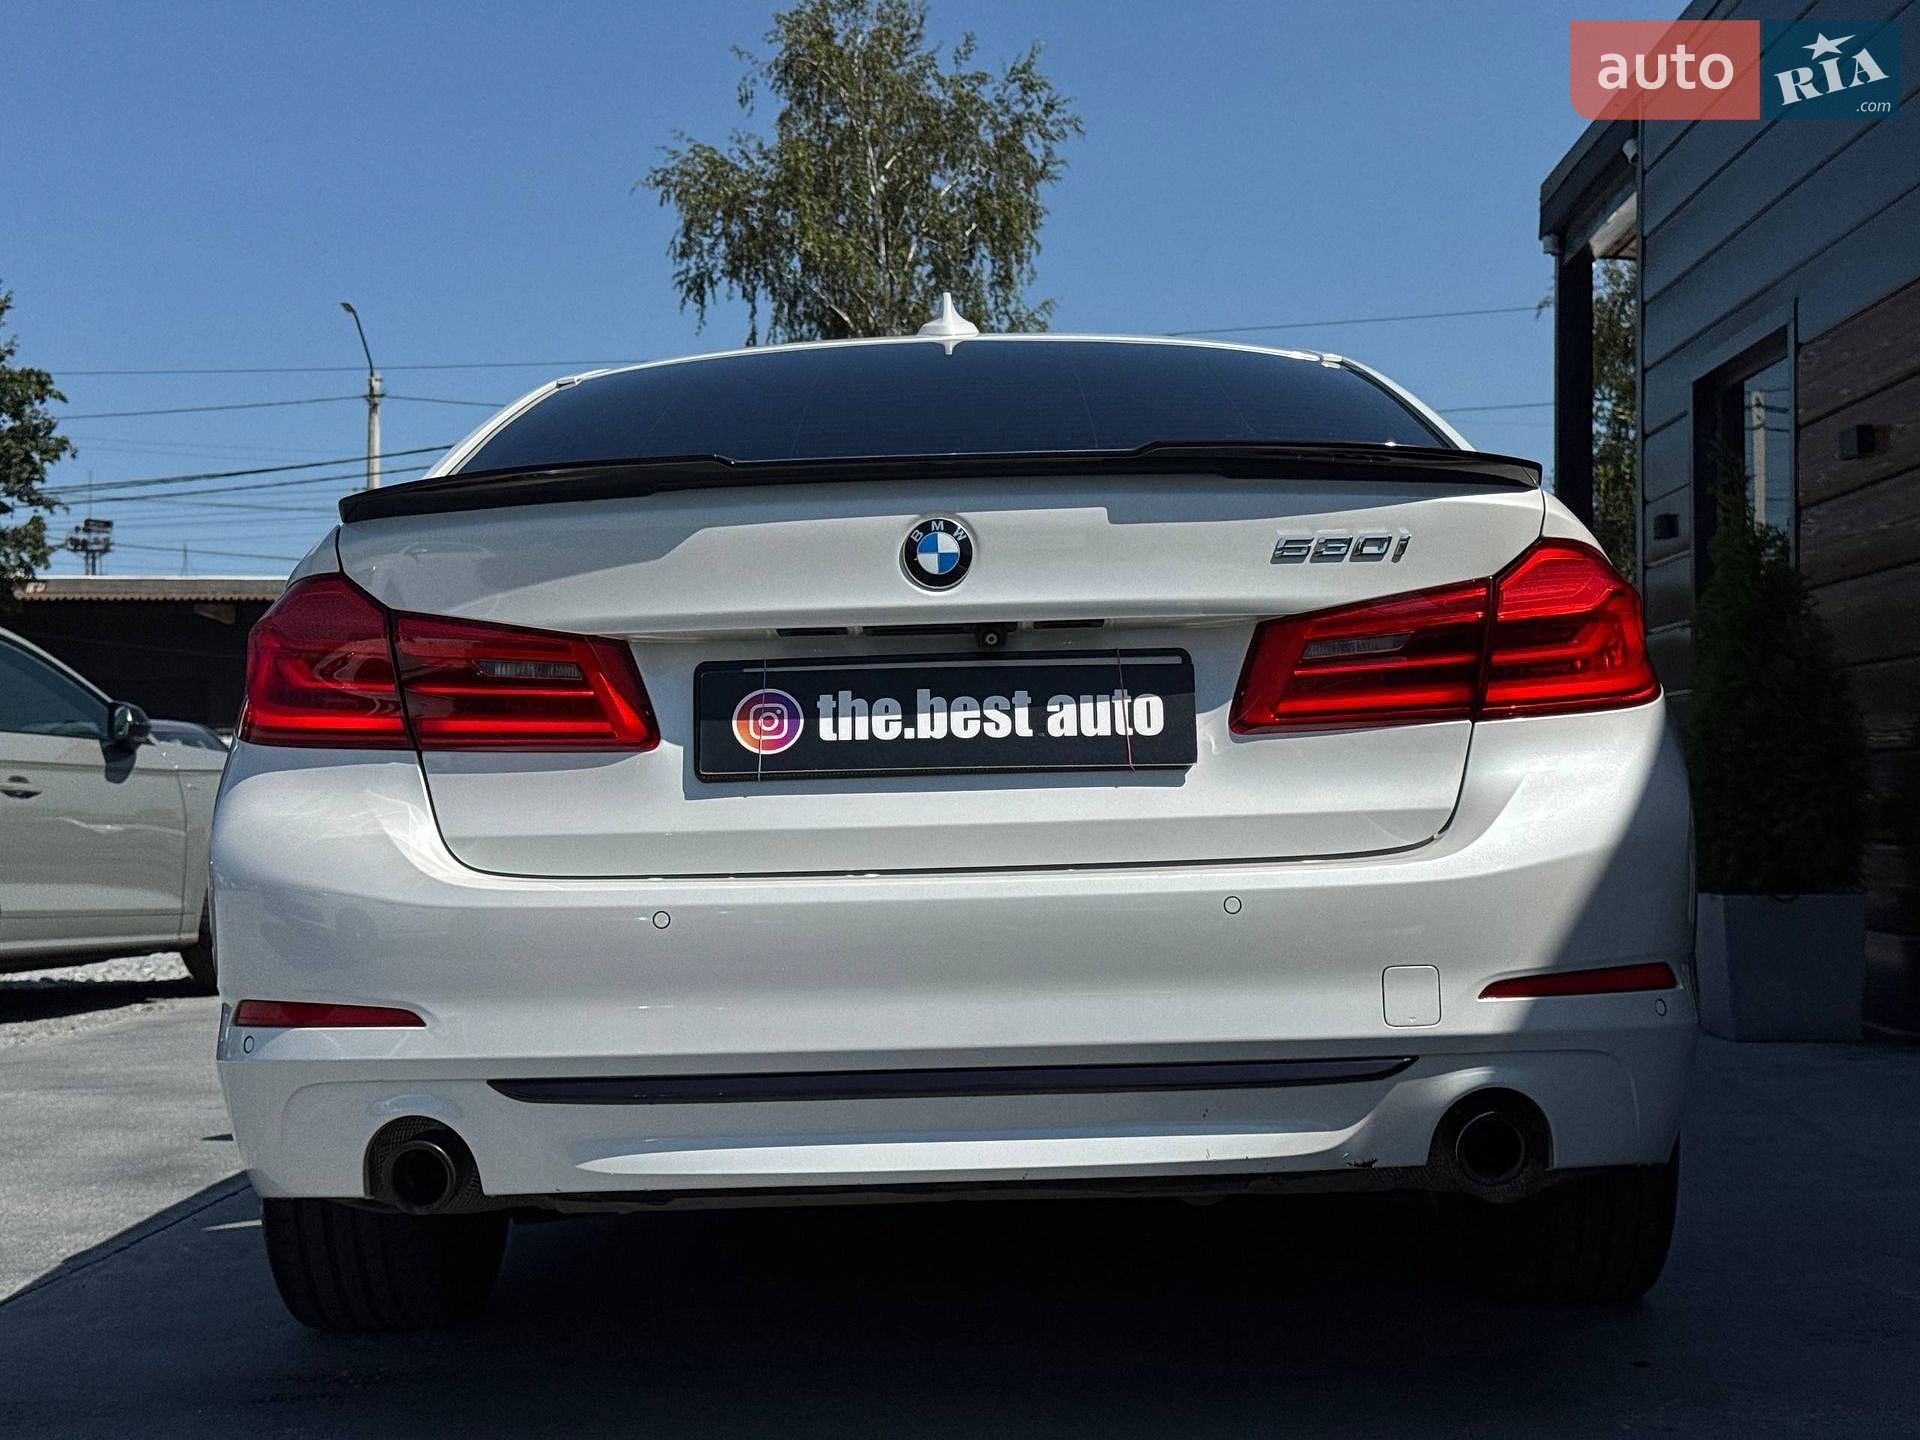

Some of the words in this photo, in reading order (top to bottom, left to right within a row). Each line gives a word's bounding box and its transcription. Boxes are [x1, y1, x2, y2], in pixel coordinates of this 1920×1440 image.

[910, 520, 967, 542] BMW
[1270, 530, 1412, 564] 530i
[816, 688, 1034, 741] the.best
[1046, 689, 1165, 738] auto
